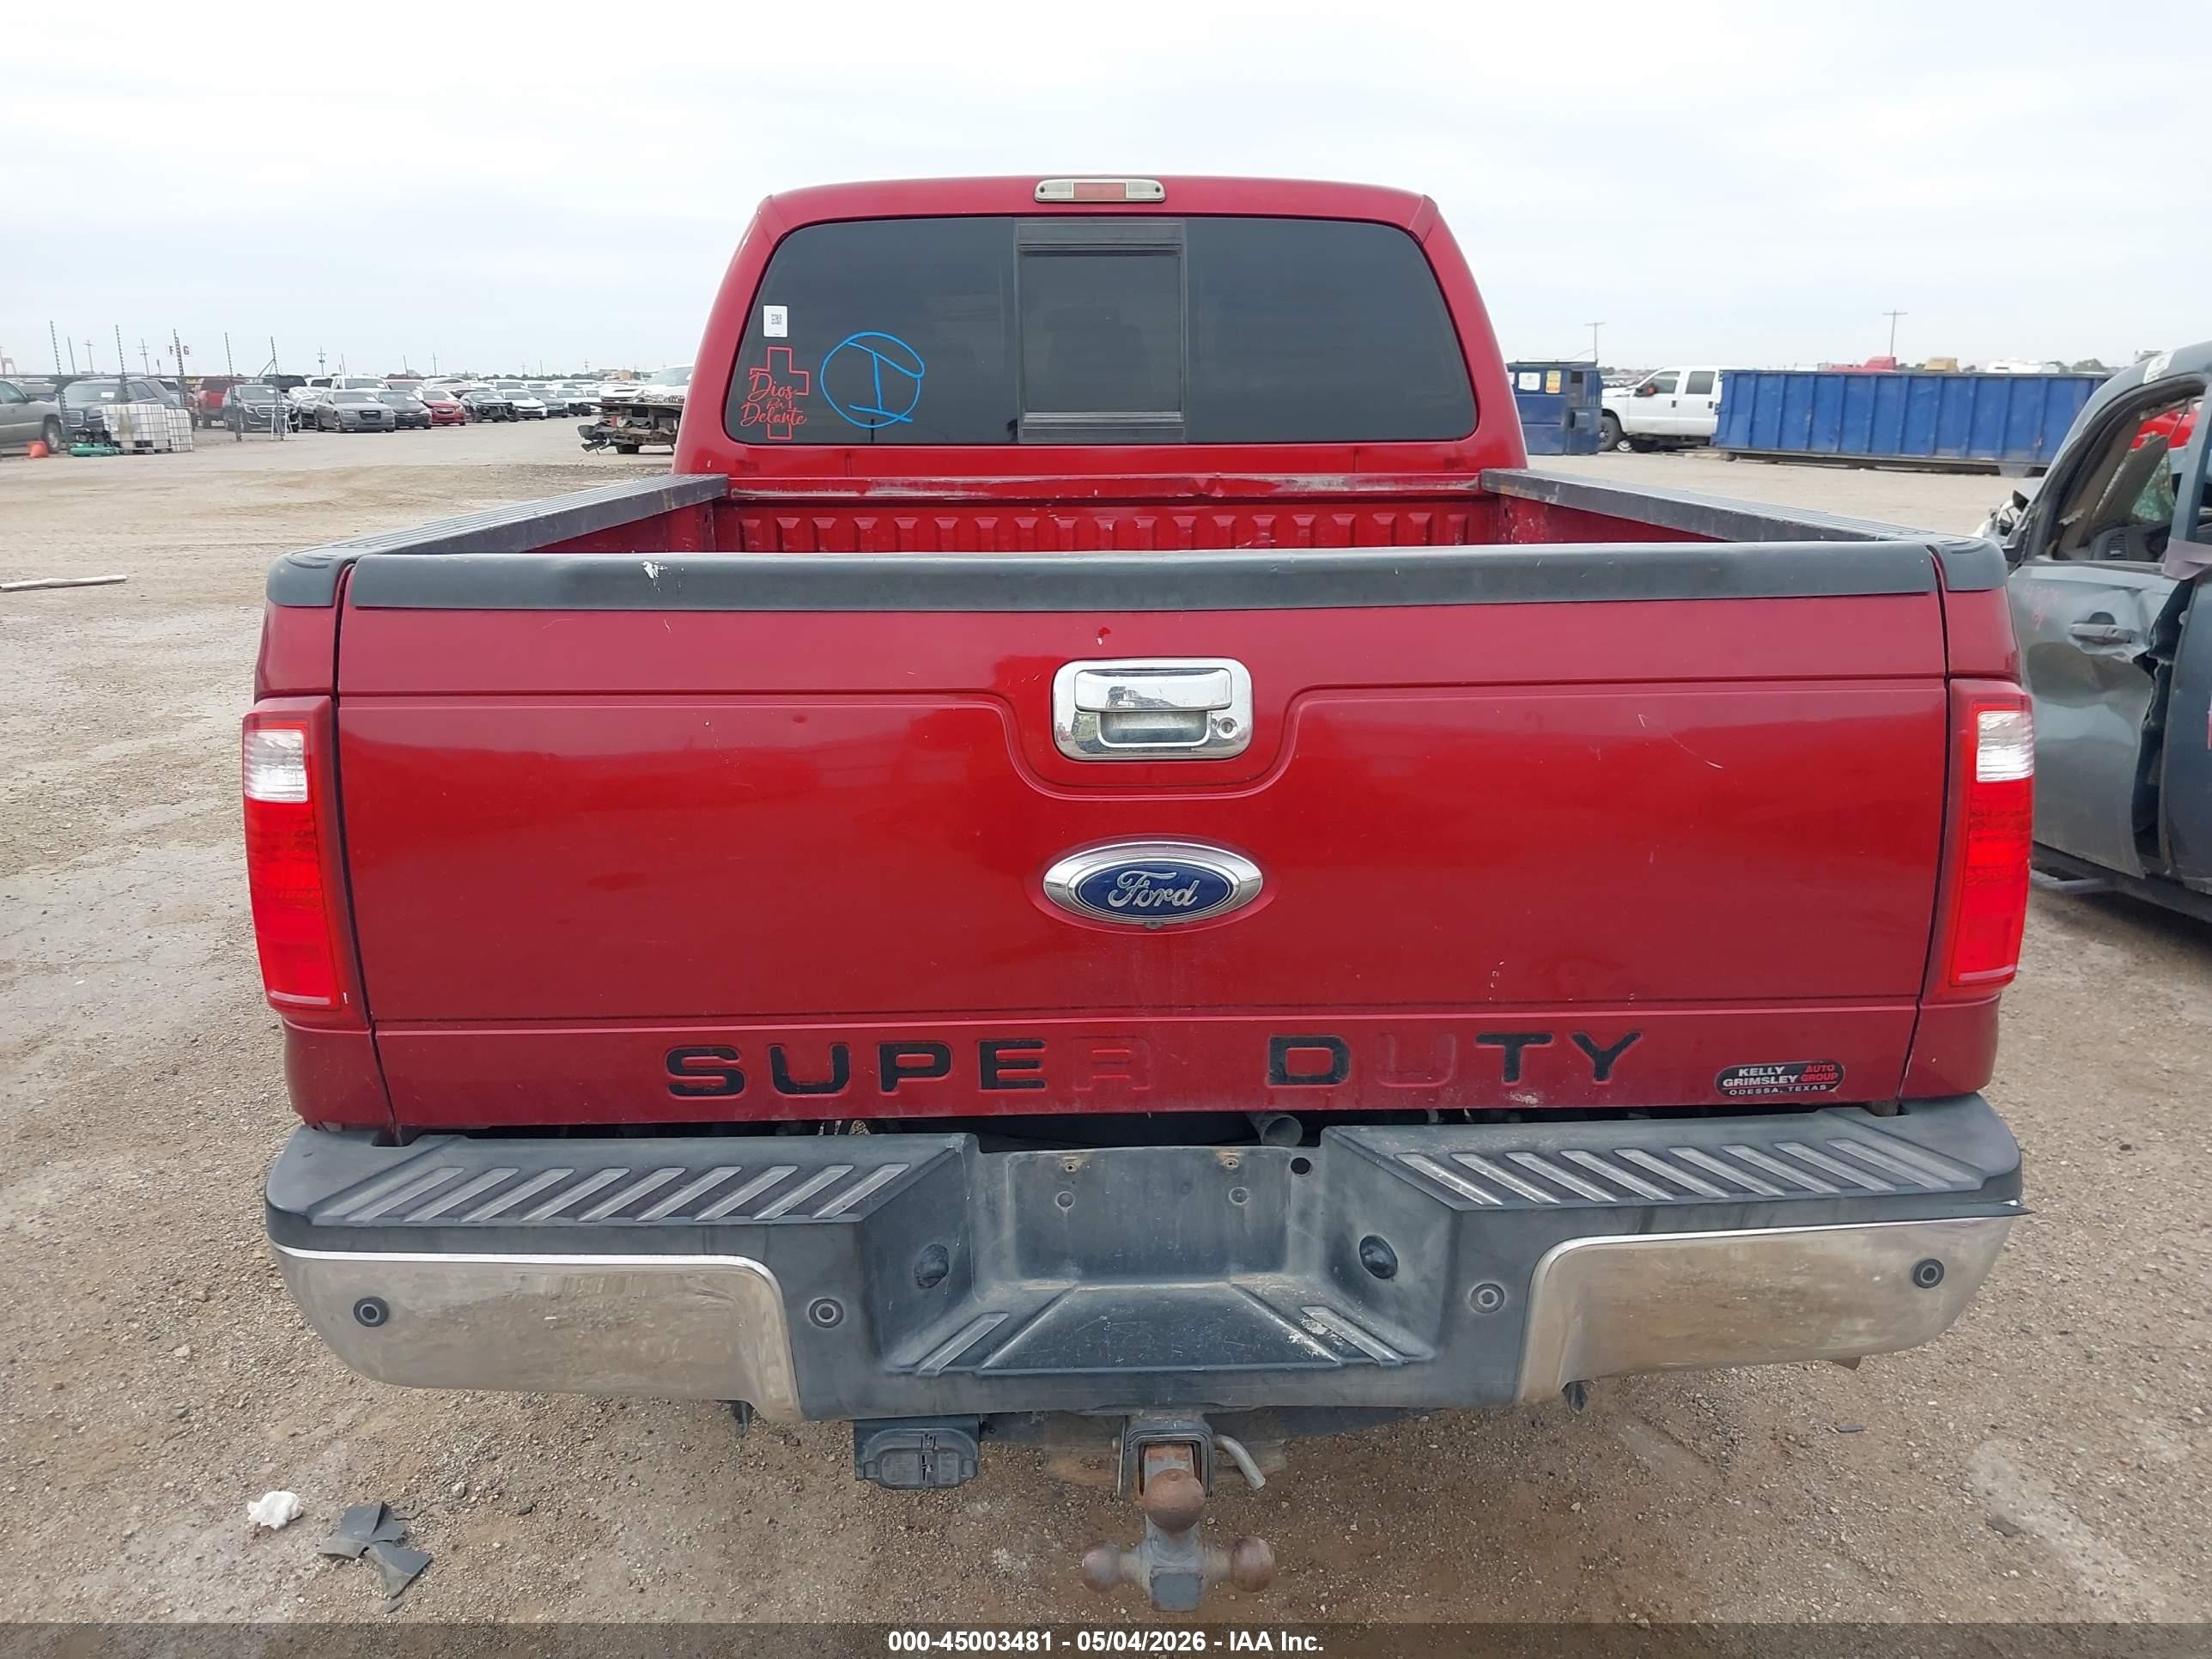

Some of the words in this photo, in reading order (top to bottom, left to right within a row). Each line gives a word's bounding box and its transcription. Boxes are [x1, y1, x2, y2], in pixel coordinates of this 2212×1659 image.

[748, 371, 797, 402] Dios
[740, 402, 807, 428] Delante
[1107, 870, 1200, 908] Ford
[665, 1036, 1152, 1100] SUPER
[1267, 1031, 1644, 1088] DUTY
[1738, 1066, 1786, 1077] KELLY
[1805, 1064, 1835, 1073] AUTO
[1723, 1074, 1799, 1087] GRIMSLEY
[1800, 1073, 1838, 1082] GROUP
[1789, 1084, 1827, 1092] TEXAS
